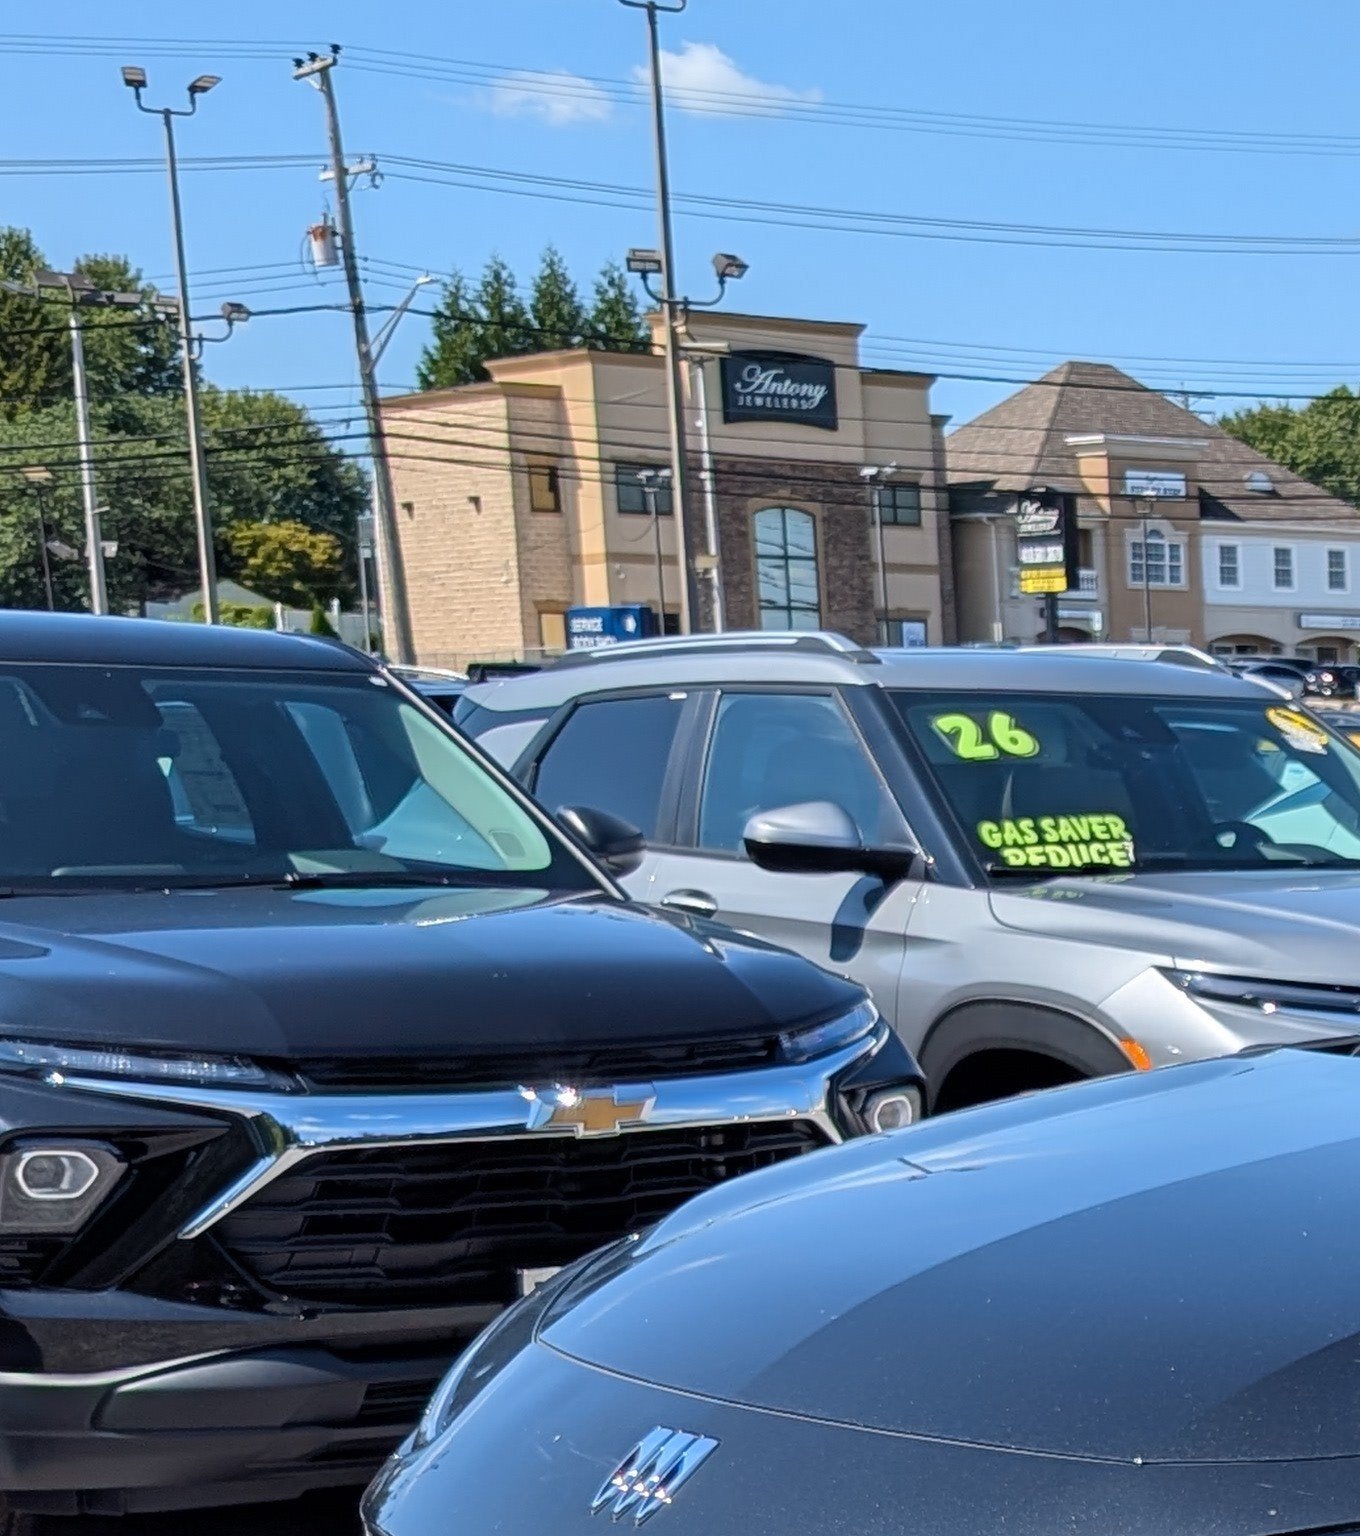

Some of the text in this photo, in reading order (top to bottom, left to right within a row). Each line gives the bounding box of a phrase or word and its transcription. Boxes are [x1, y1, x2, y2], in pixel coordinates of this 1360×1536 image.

[733, 364, 828, 410] Antony
[737, 395, 813, 410] JEWELERS
[932, 711, 1040, 762] 26
[977, 812, 1134, 849] GAS SAVER
